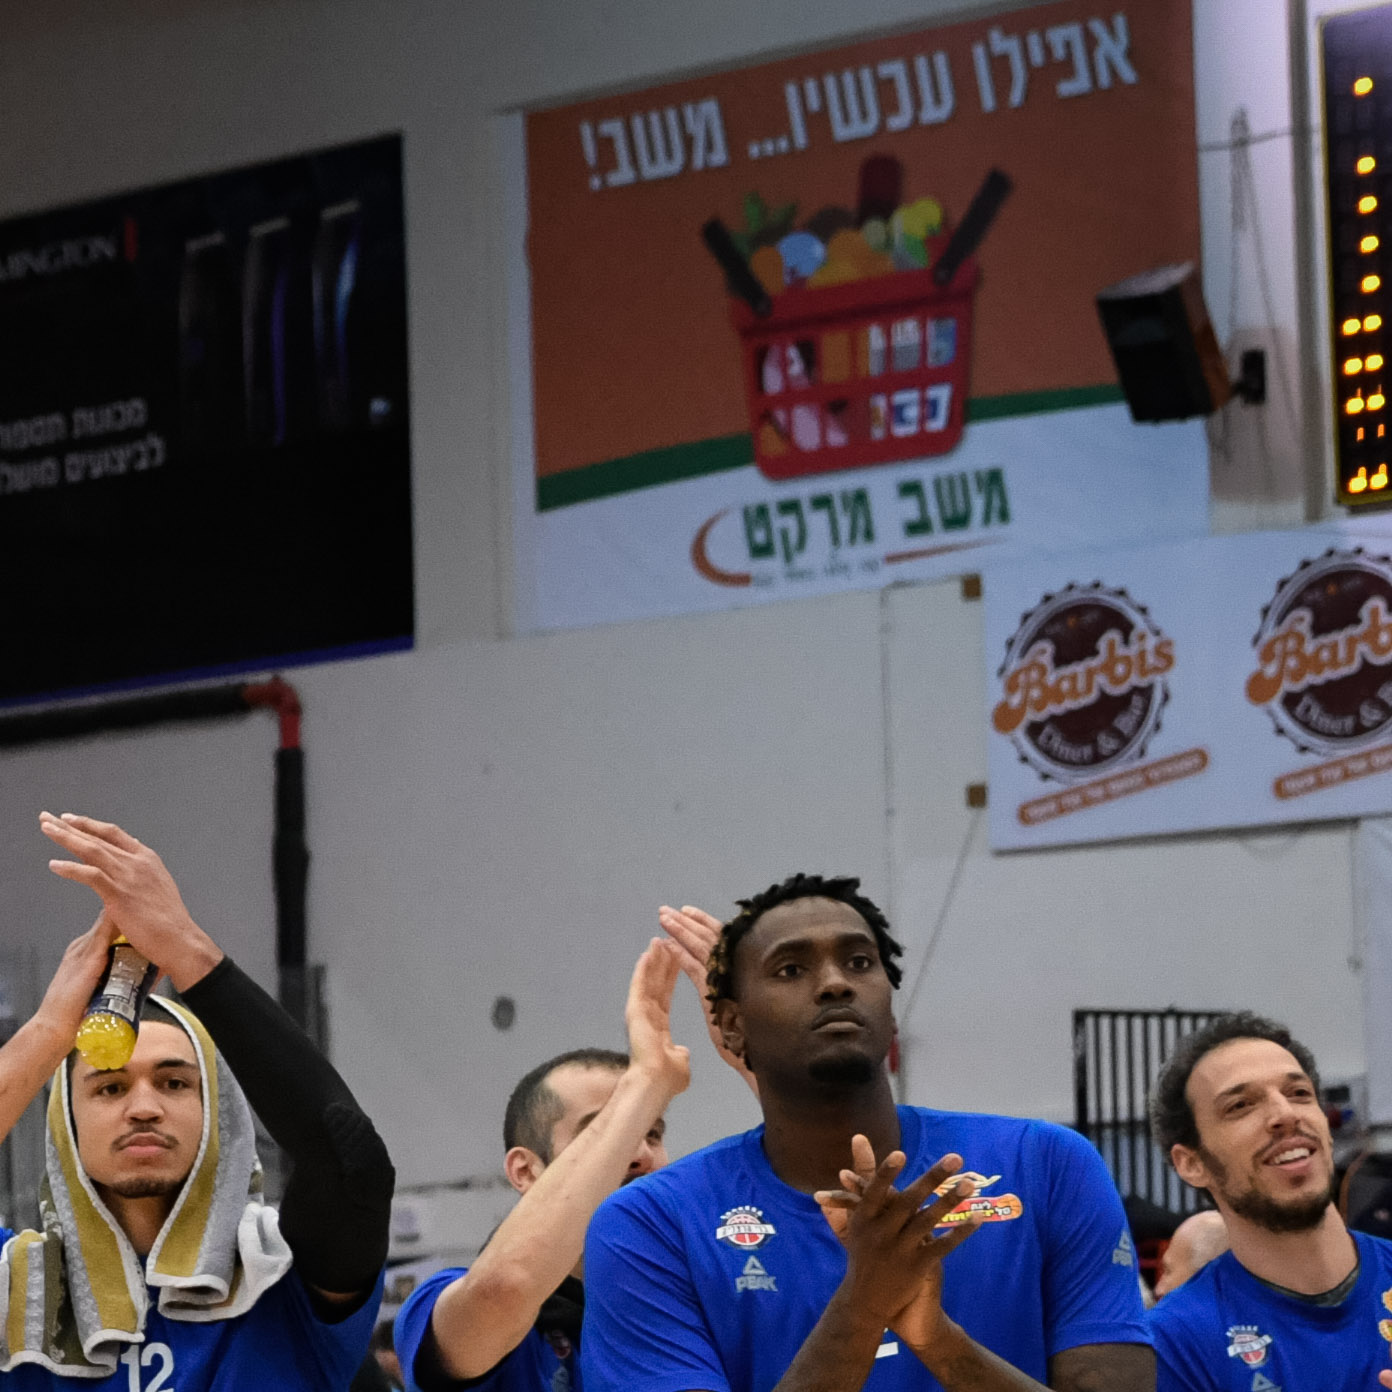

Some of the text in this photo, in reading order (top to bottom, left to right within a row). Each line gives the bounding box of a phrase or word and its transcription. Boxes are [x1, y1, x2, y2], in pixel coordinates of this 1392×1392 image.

[579, 14, 1137, 191] אפילו עכשיו... משב!
[743, 468, 1011, 563] משב מרקט
[993, 632, 1174, 734] Barbis
[1246, 603, 1392, 705] Barb
[735, 1275, 779, 1293] PEAK
